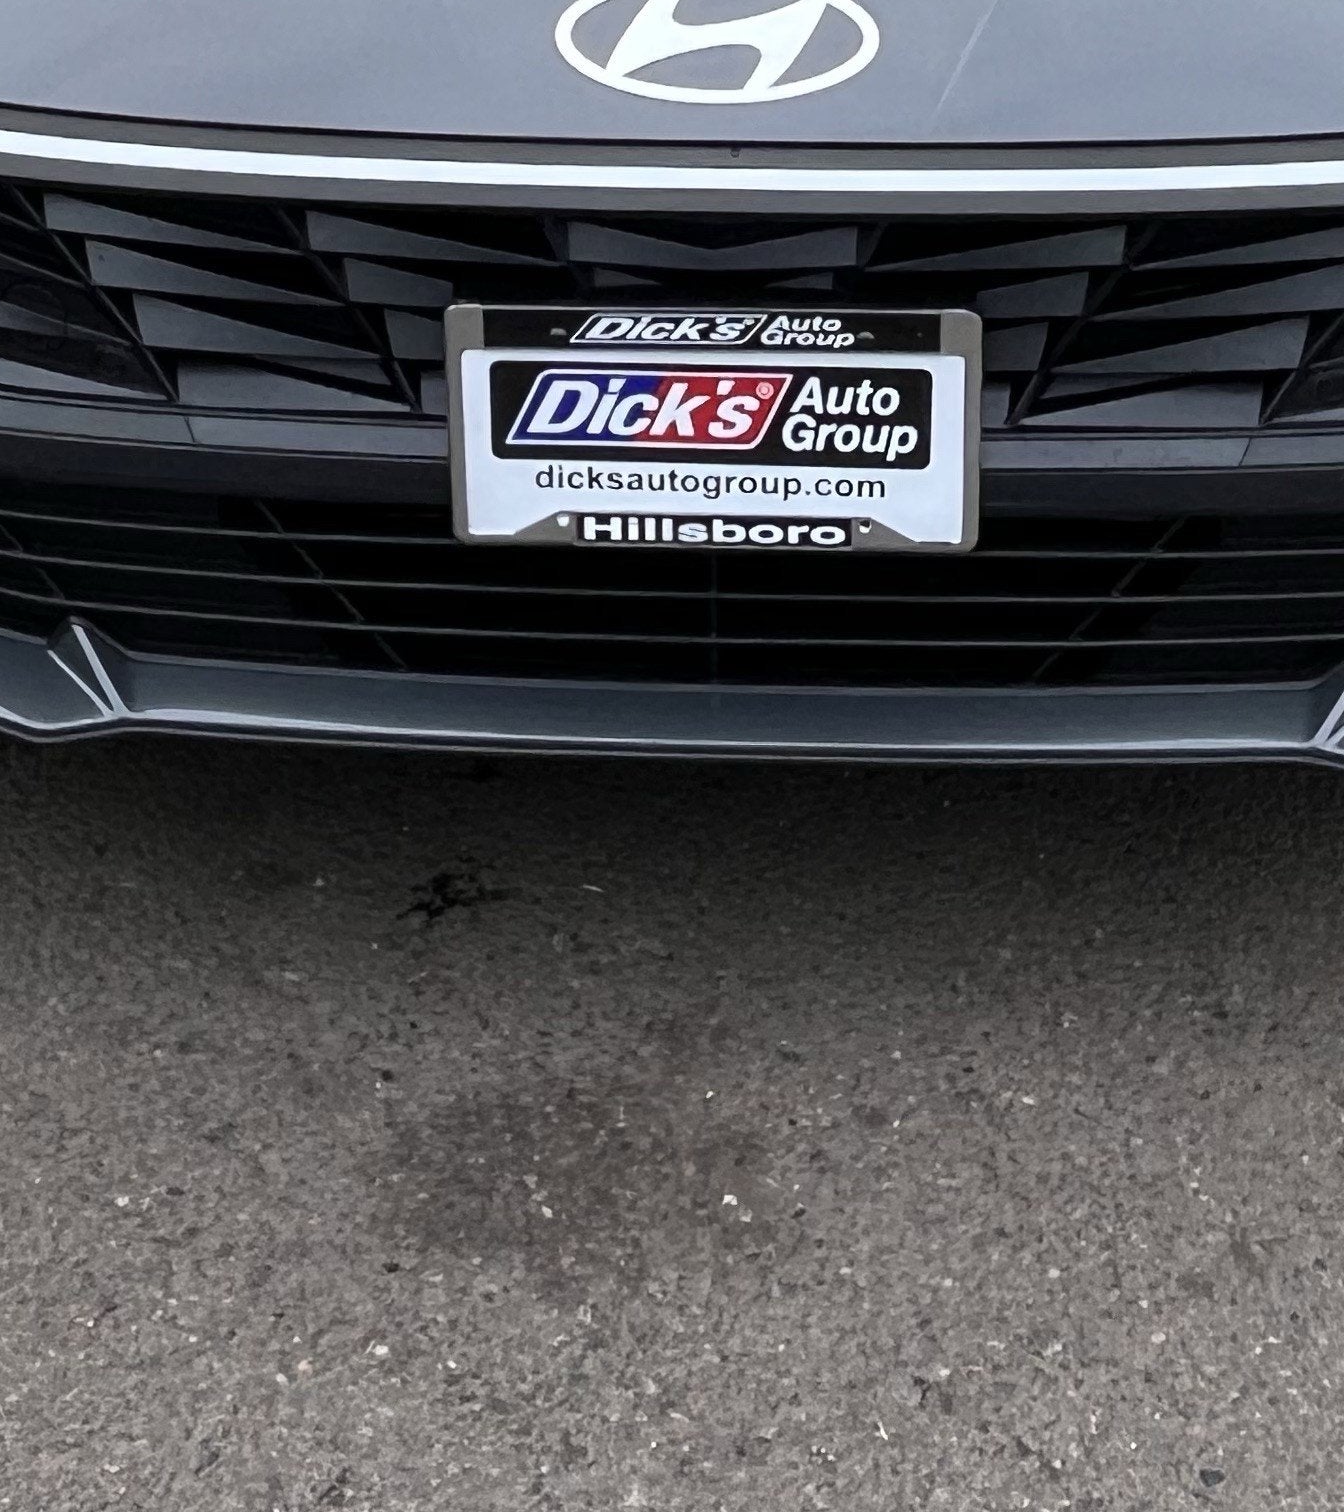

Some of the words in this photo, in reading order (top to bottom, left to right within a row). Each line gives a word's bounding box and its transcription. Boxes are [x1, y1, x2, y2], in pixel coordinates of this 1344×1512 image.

[584, 315, 747, 341] Dick's
[760, 329, 856, 349] Group
[773, 315, 842, 332] Auto
[525, 377, 761, 439] Dick's
[789, 376, 900, 417] Auto
[782, 414, 919, 461] Group
[535, 464, 886, 502] dicksautogroup.com
[583, 515, 846, 546] Hillsboro
